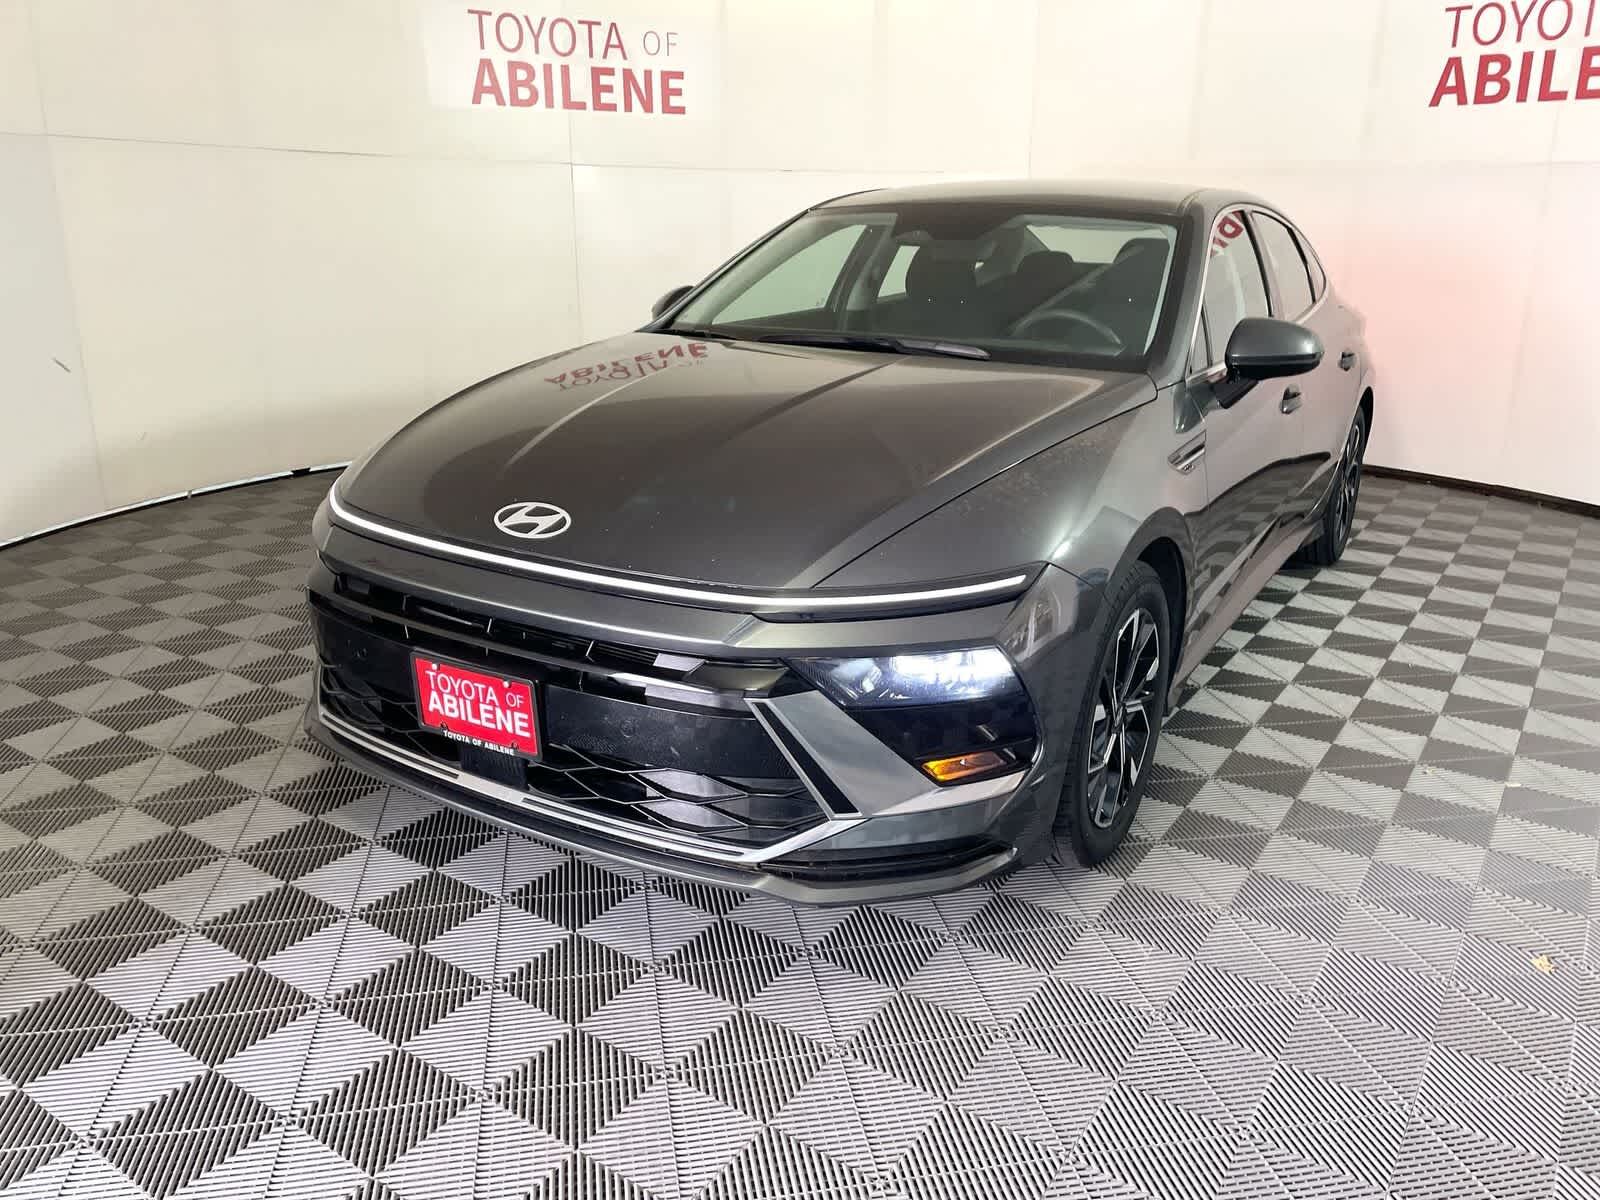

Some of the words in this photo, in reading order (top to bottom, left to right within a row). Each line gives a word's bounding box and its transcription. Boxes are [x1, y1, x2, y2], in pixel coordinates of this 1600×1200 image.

[467, 9, 628, 60] TOYOTA
[643, 30, 678, 56] OF
[471, 58, 686, 115] ABILENE
[425, 670, 499, 706] TOYOTA
[505, 692, 524, 708] OF
[428, 691, 531, 738] ABILENE
[443, 730, 470, 744] TOYOTA
[472, 739, 482, 747] OF
[484, 741, 515, 756] ABILENE
